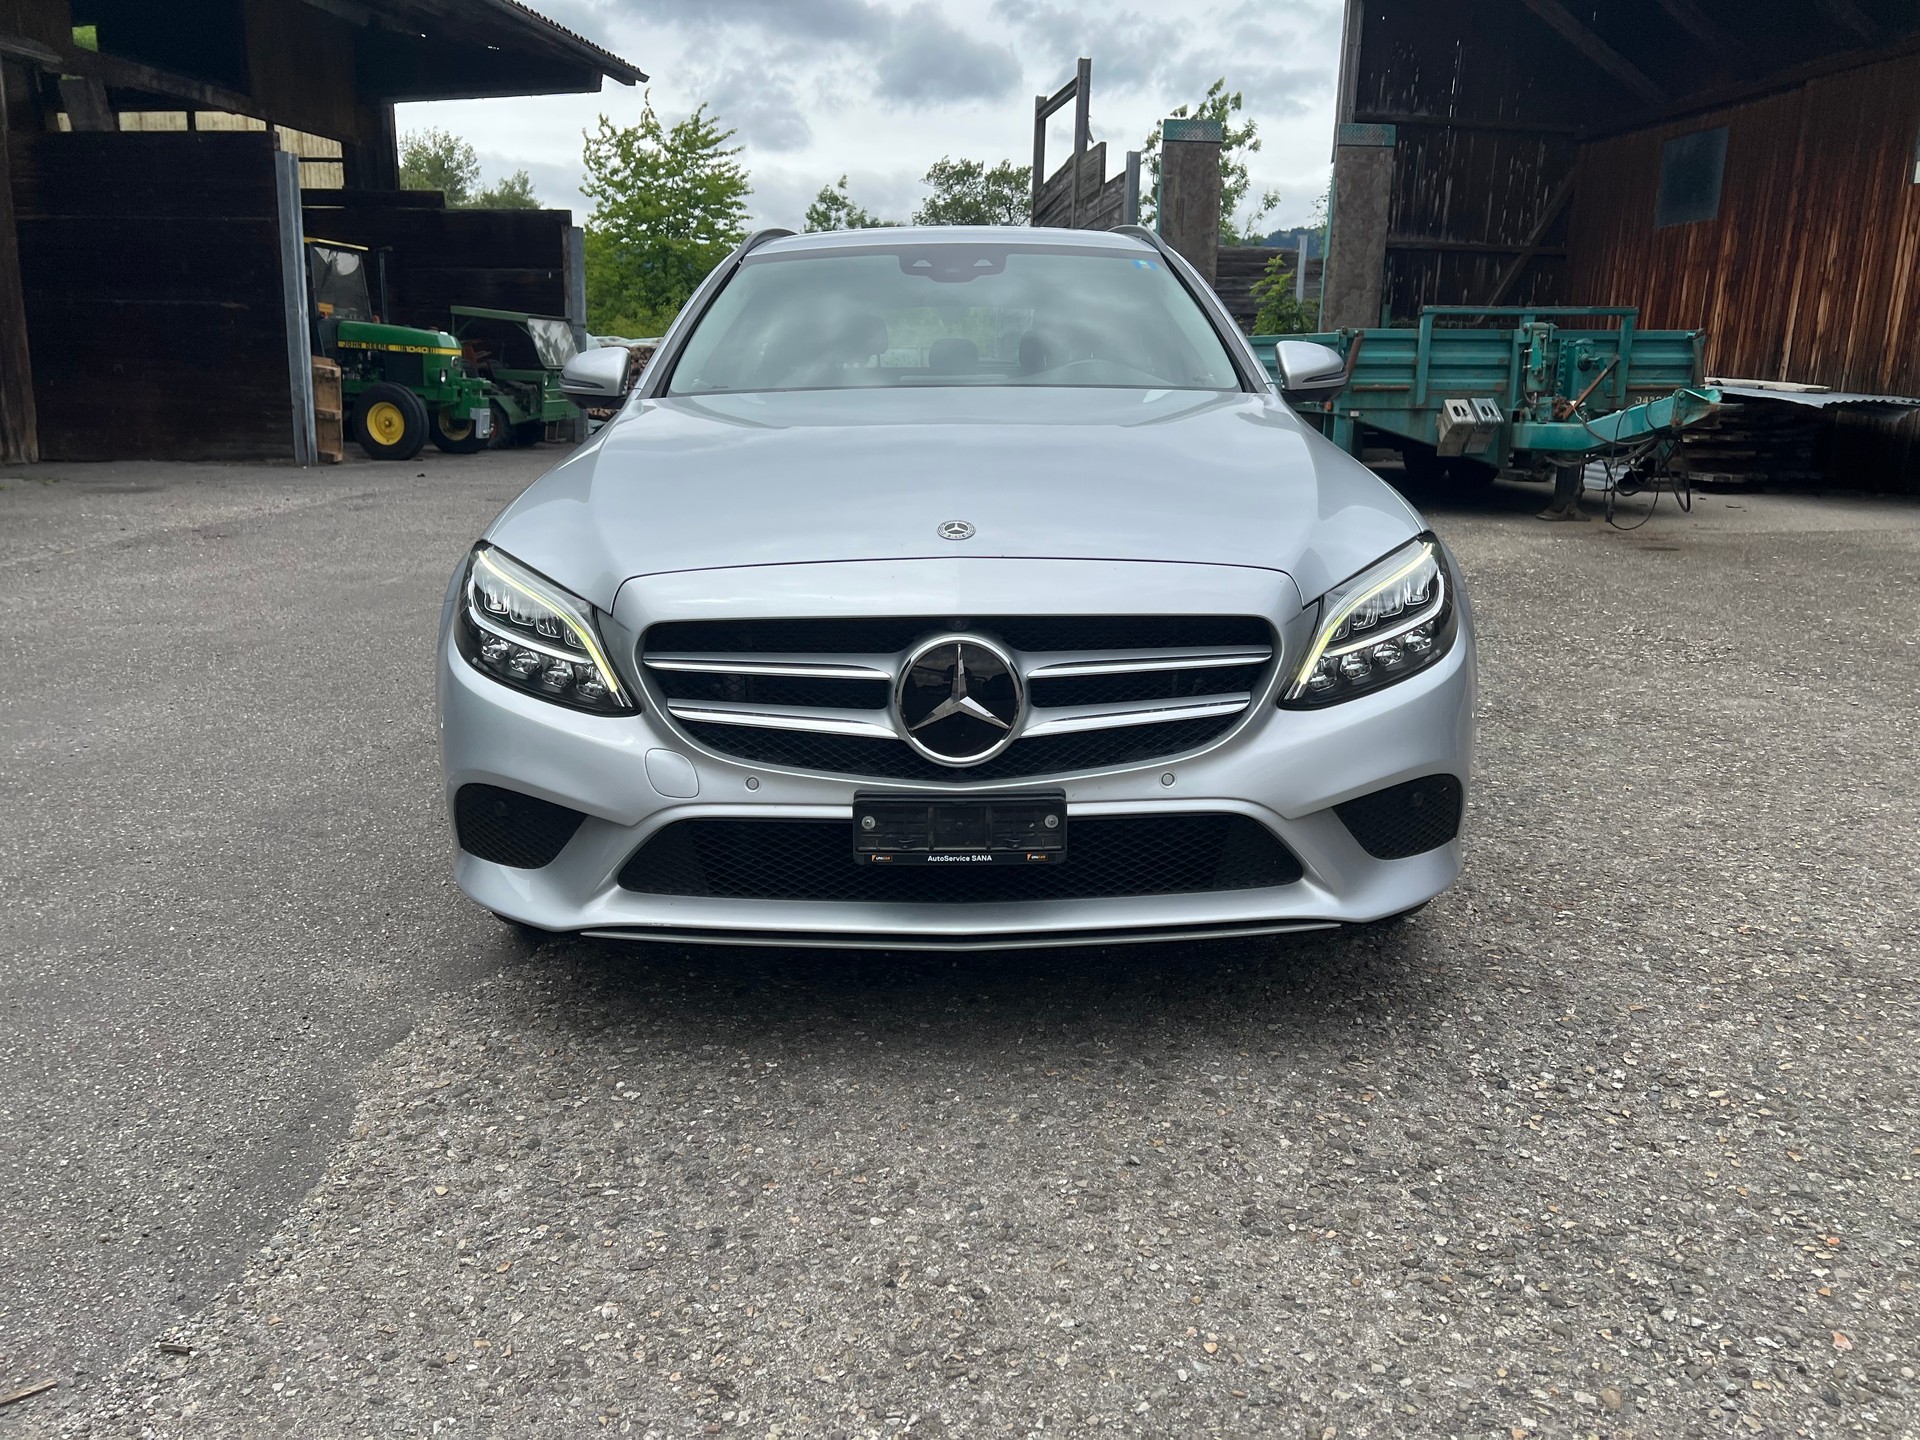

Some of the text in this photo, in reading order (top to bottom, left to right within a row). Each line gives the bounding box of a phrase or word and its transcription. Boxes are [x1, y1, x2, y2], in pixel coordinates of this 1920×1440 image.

[343, 341, 428, 353] JOHN DEERE 1040
[971, 854, 993, 862] SANA
